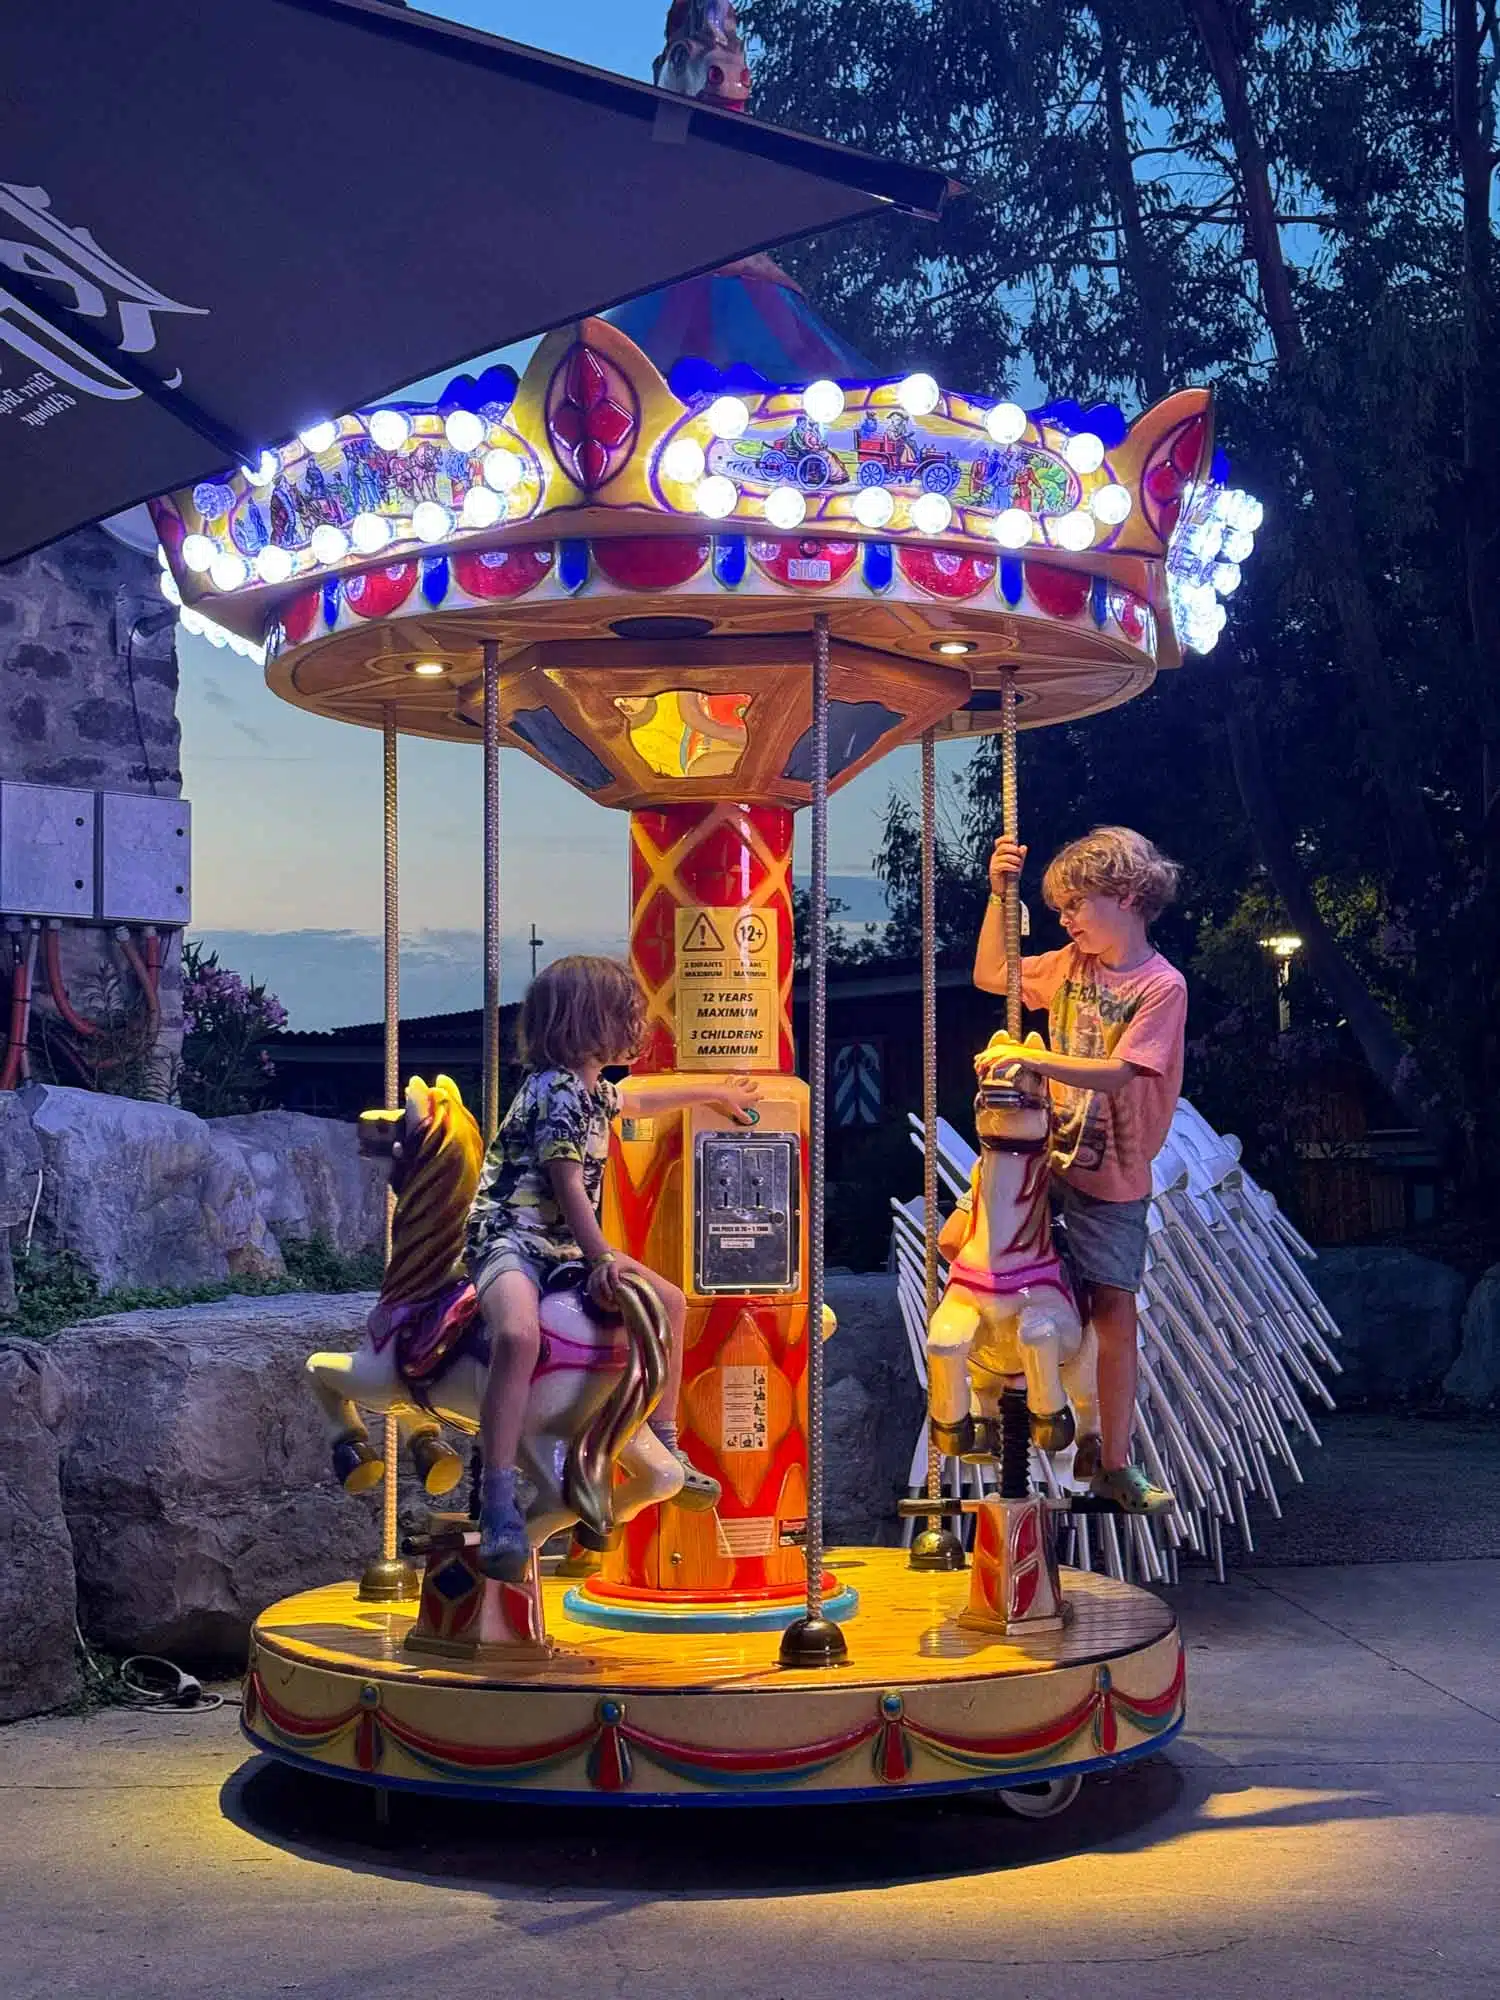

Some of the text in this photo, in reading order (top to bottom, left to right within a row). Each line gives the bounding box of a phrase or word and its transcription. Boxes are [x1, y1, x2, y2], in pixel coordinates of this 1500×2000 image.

[702, 993, 753, 1002] 12 YEARS
[697, 1008, 758, 1018] MAXIMUM
[690, 1030, 764, 1040] 3 CHILDRENS
[697, 1045, 758, 1055] MAXIMUM
